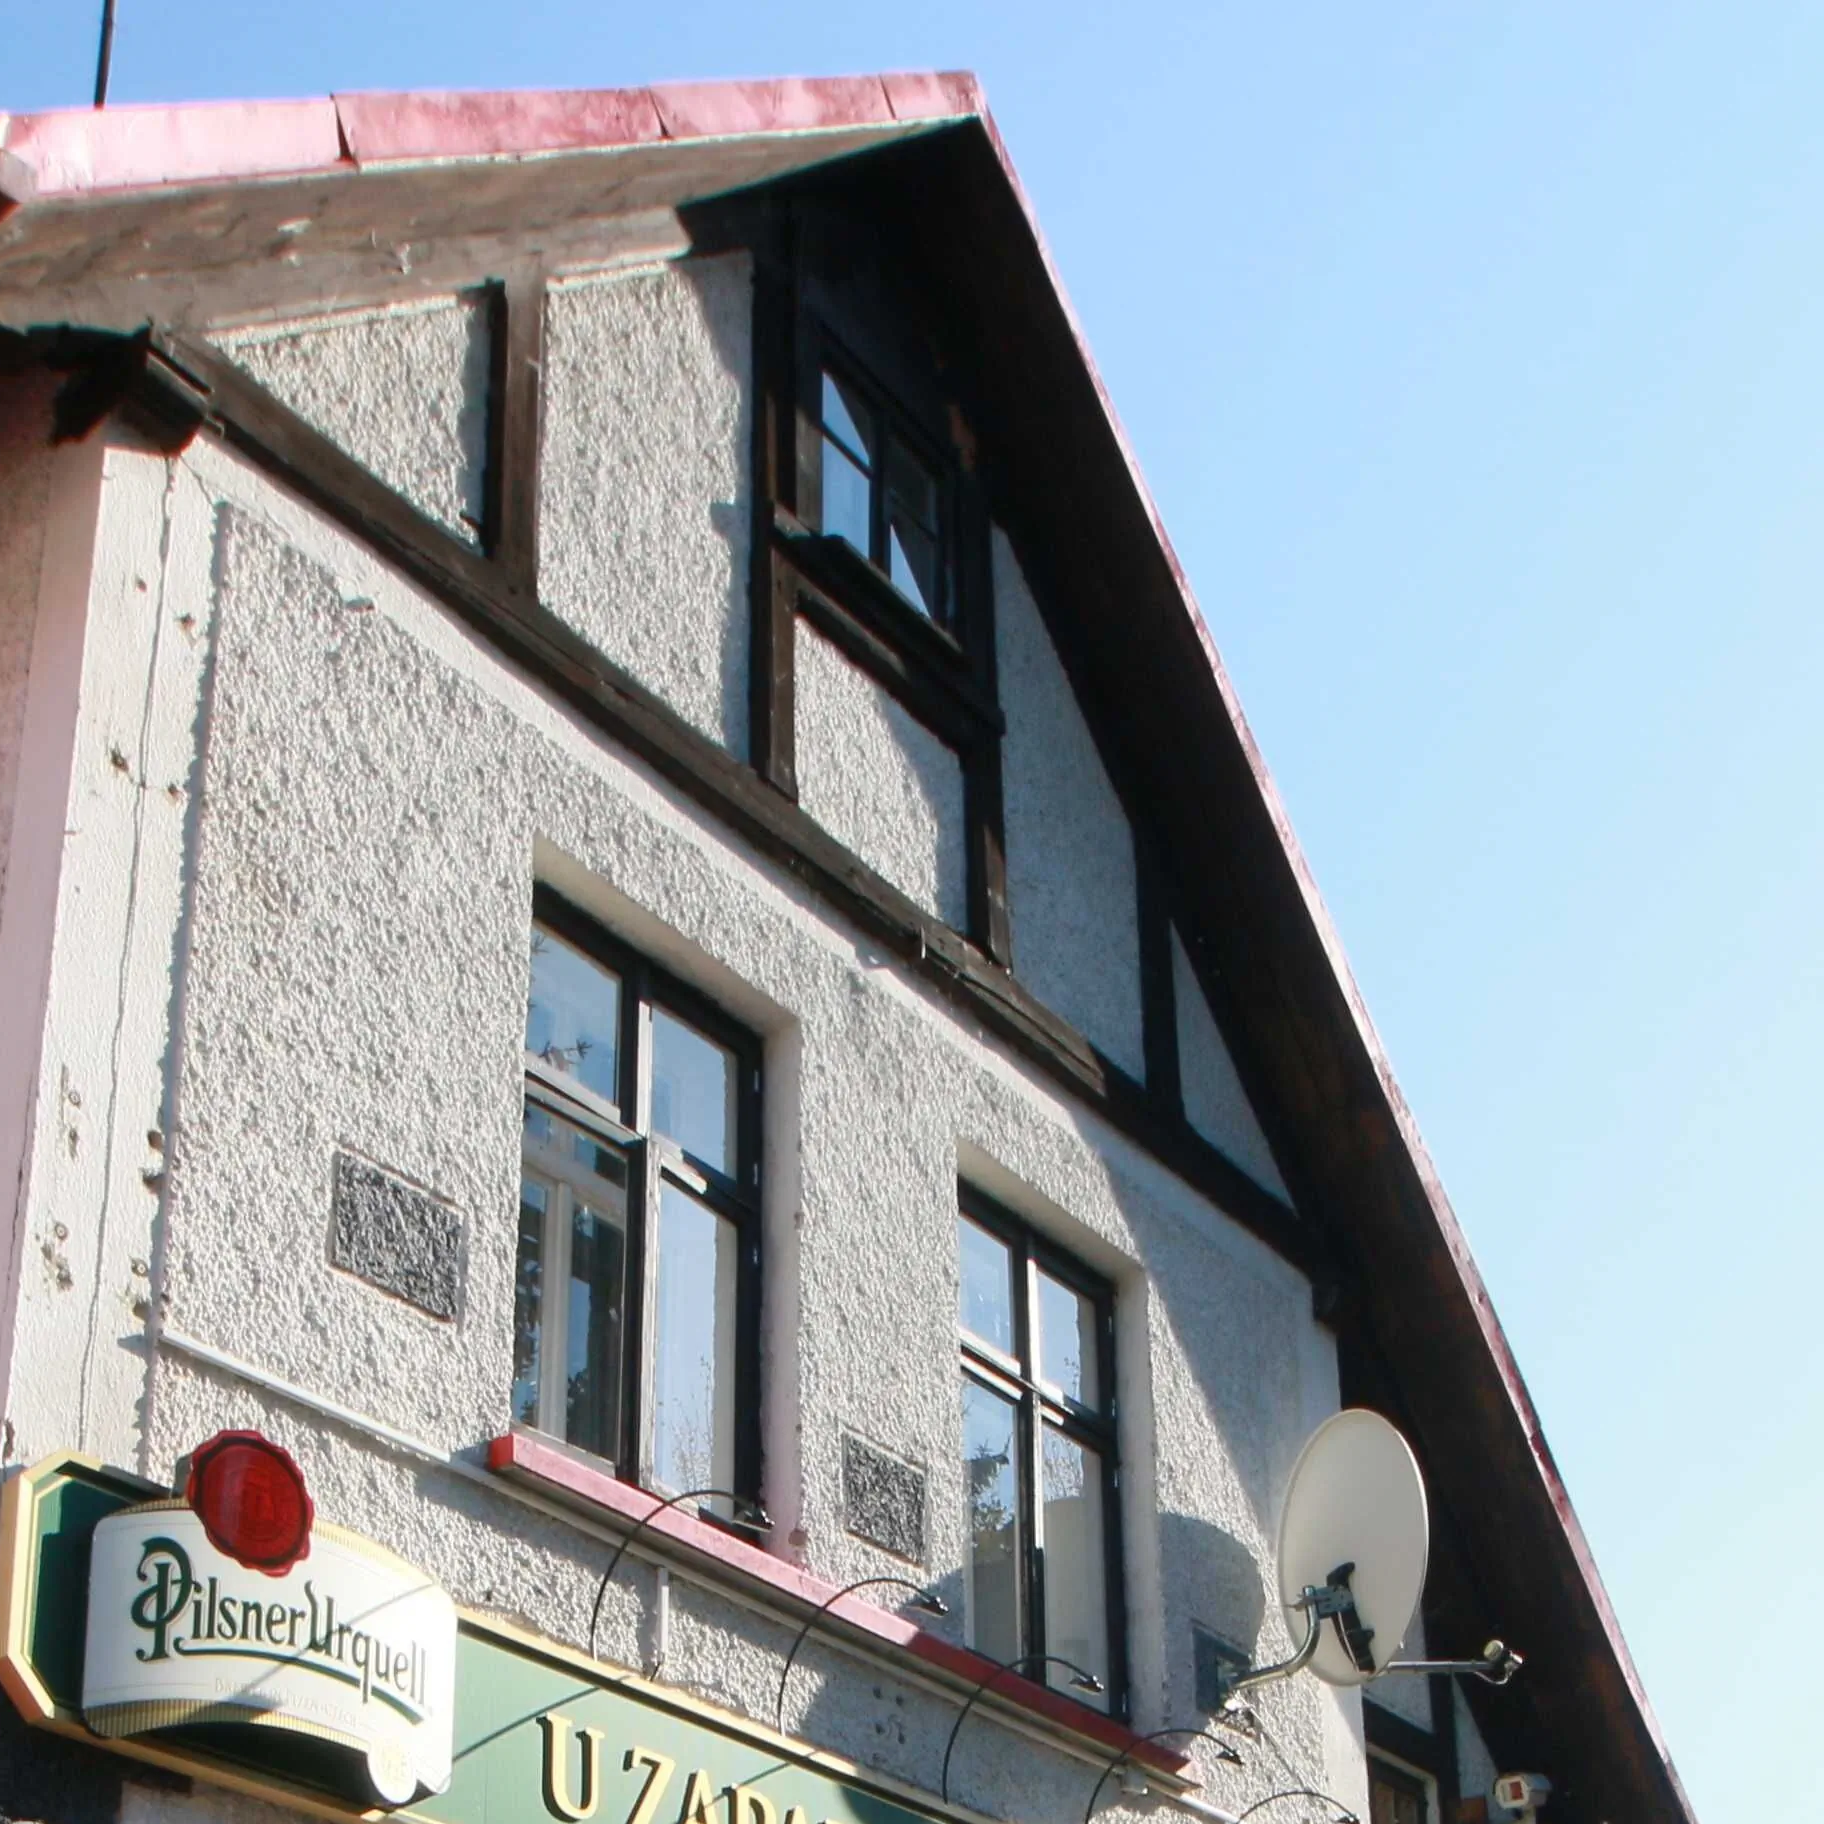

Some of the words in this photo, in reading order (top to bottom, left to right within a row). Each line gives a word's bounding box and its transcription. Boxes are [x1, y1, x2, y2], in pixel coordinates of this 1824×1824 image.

[130, 1535, 307, 1663] Pilsner
[304, 1579, 427, 1705] Urquell
[536, 1712, 605, 1824] U
